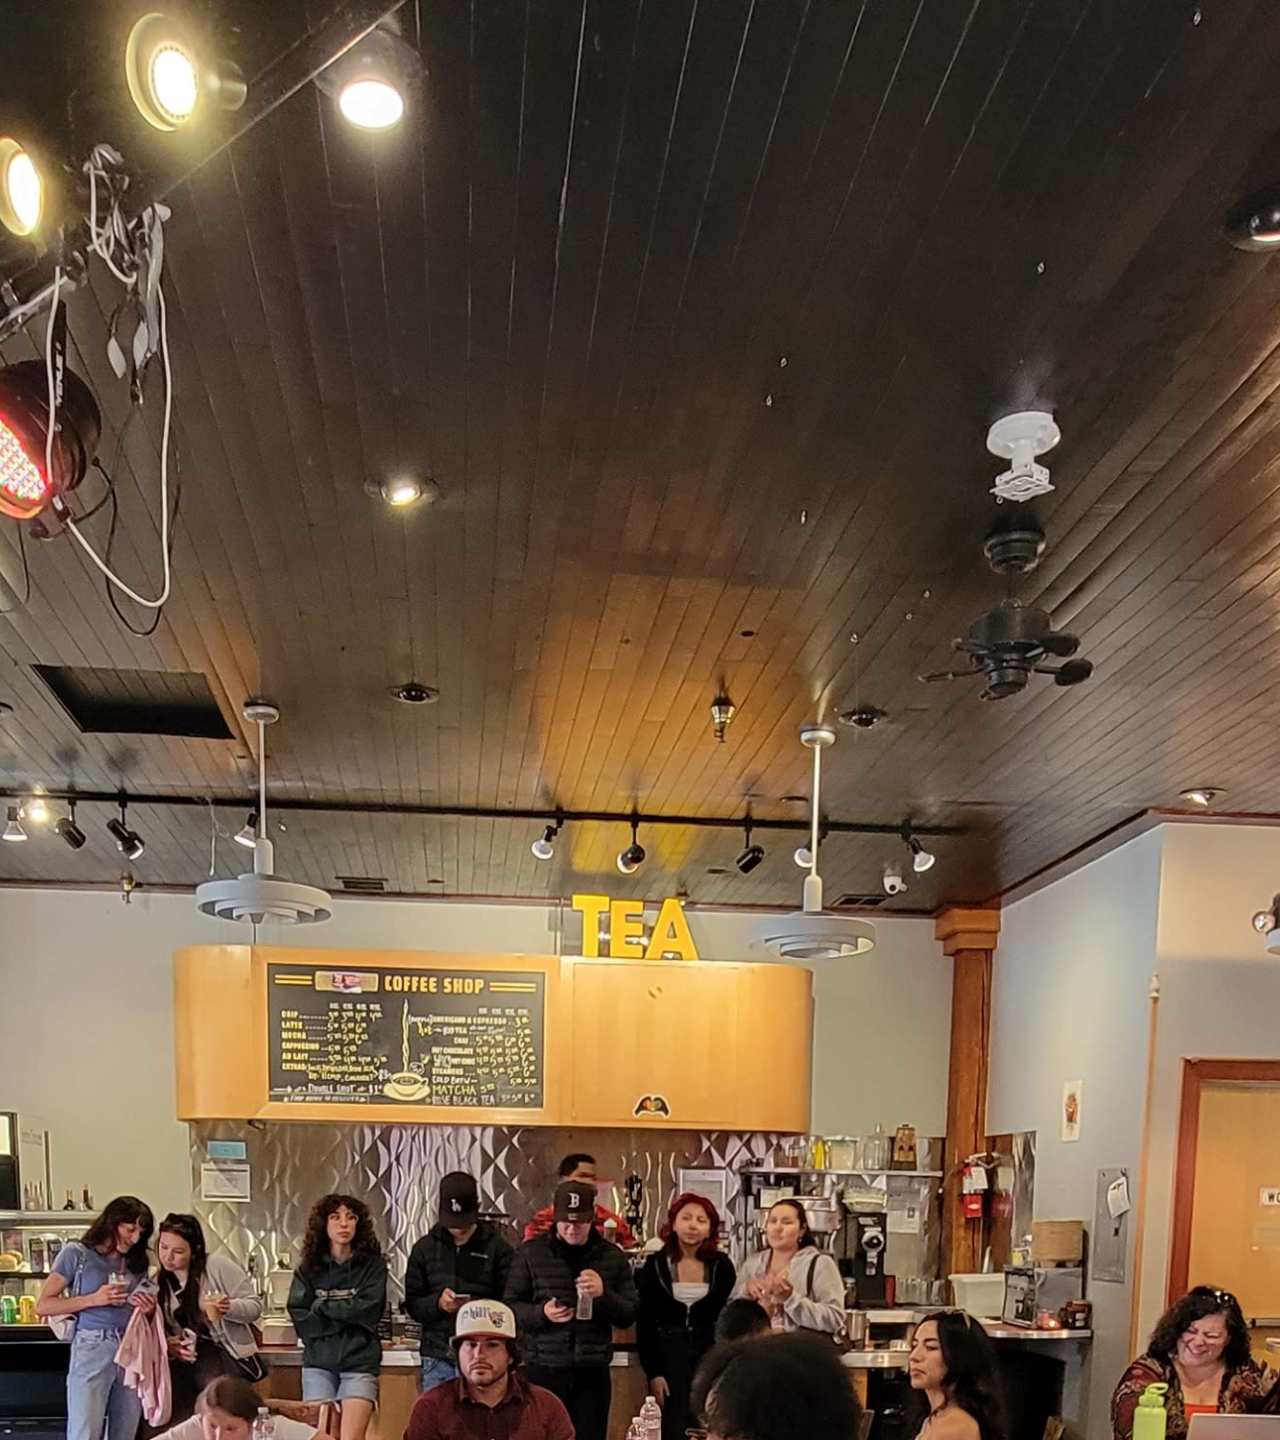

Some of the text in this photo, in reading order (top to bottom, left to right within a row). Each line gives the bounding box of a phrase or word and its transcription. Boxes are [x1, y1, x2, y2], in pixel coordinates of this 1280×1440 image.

[572, 894, 699, 960] TEA
[384, 975, 485, 994] COFFEE SHOP
[432, 1076, 449, 1084] COLD
[432, 1084, 477, 1095] MATCHA
[481, 1095, 495, 1105] TEA
[568, 1192, 580, 1208] B
